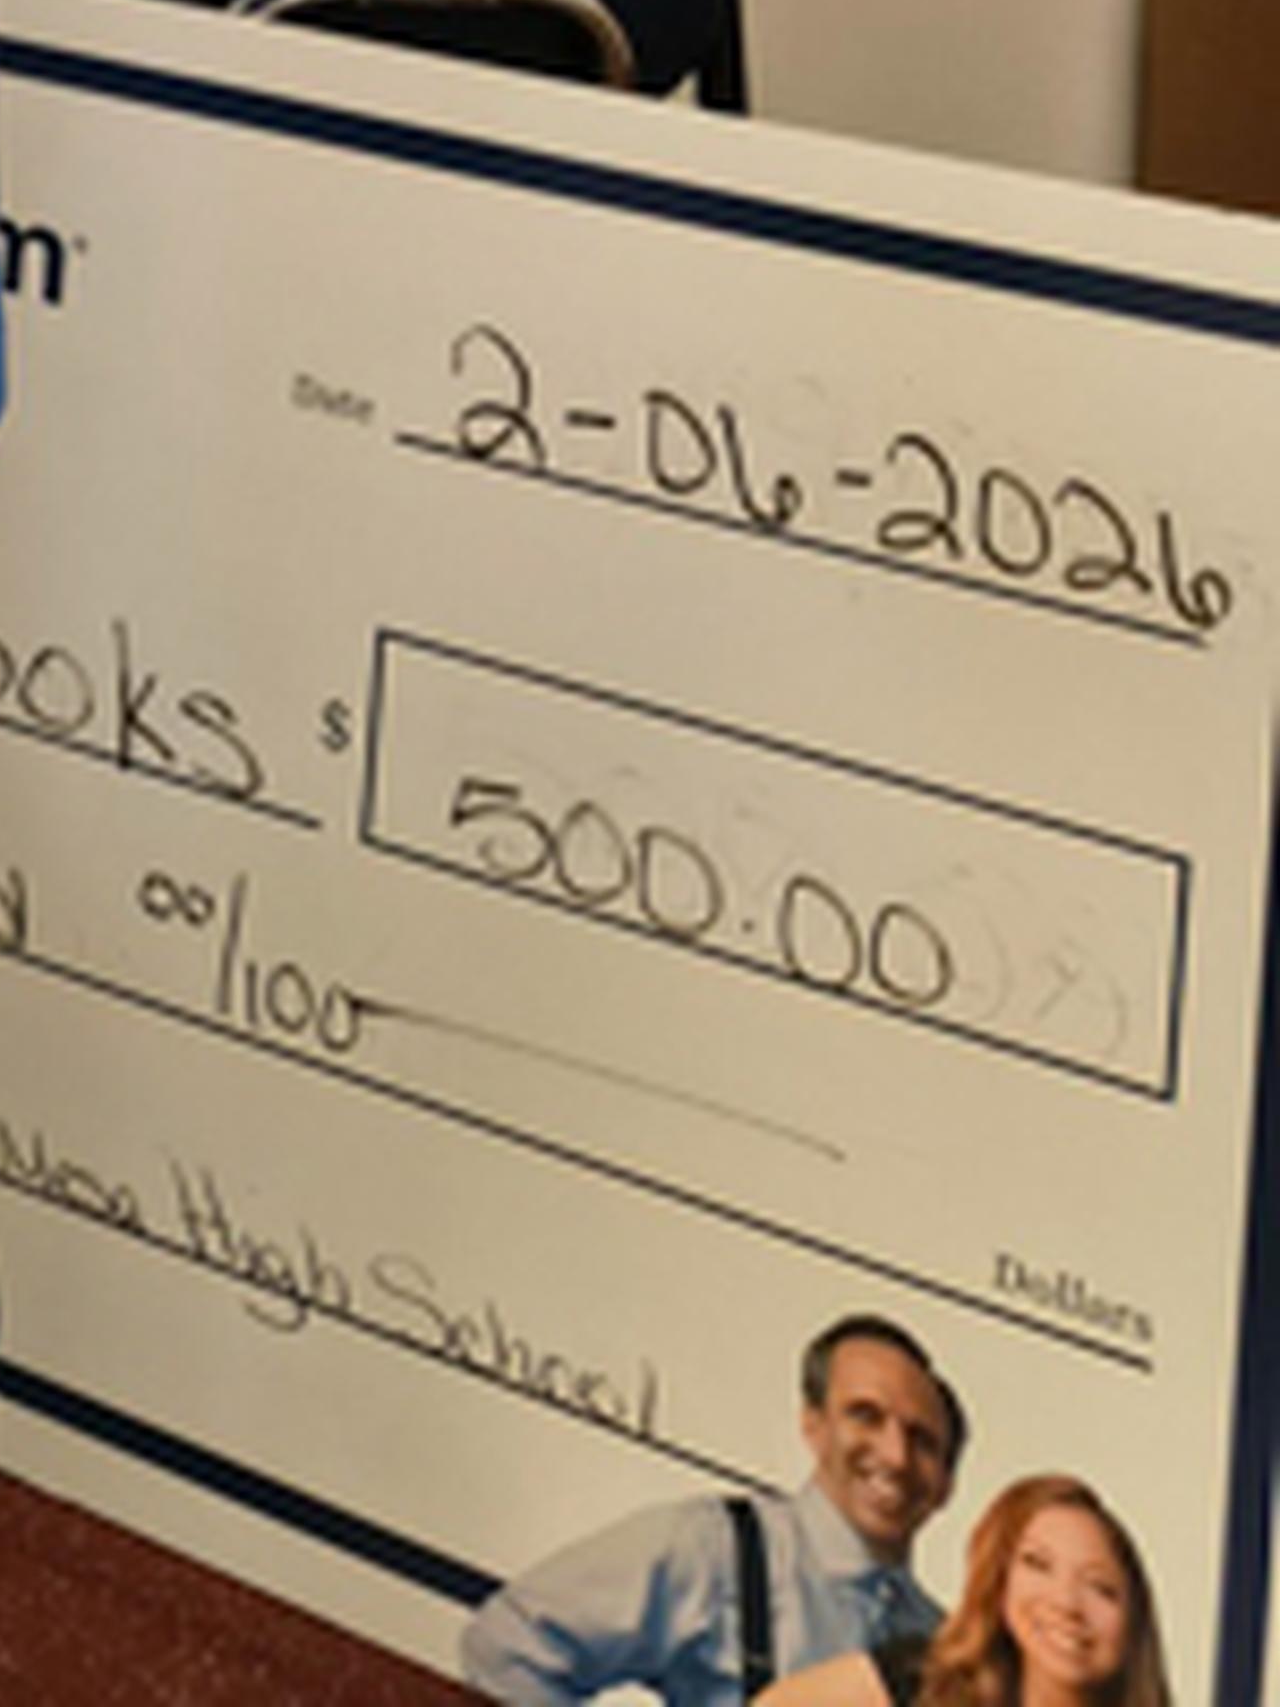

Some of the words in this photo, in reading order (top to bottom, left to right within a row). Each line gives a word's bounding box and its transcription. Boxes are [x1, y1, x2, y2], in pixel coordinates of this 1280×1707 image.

[451, 324, 1233, 629] 2-06-2026
[317, 694, 353, 754] $
[451, 777, 954, 1008] 500.00
[366, 1251, 659, 1440] School
[994, 1251, 1155, 1344] Dollars
